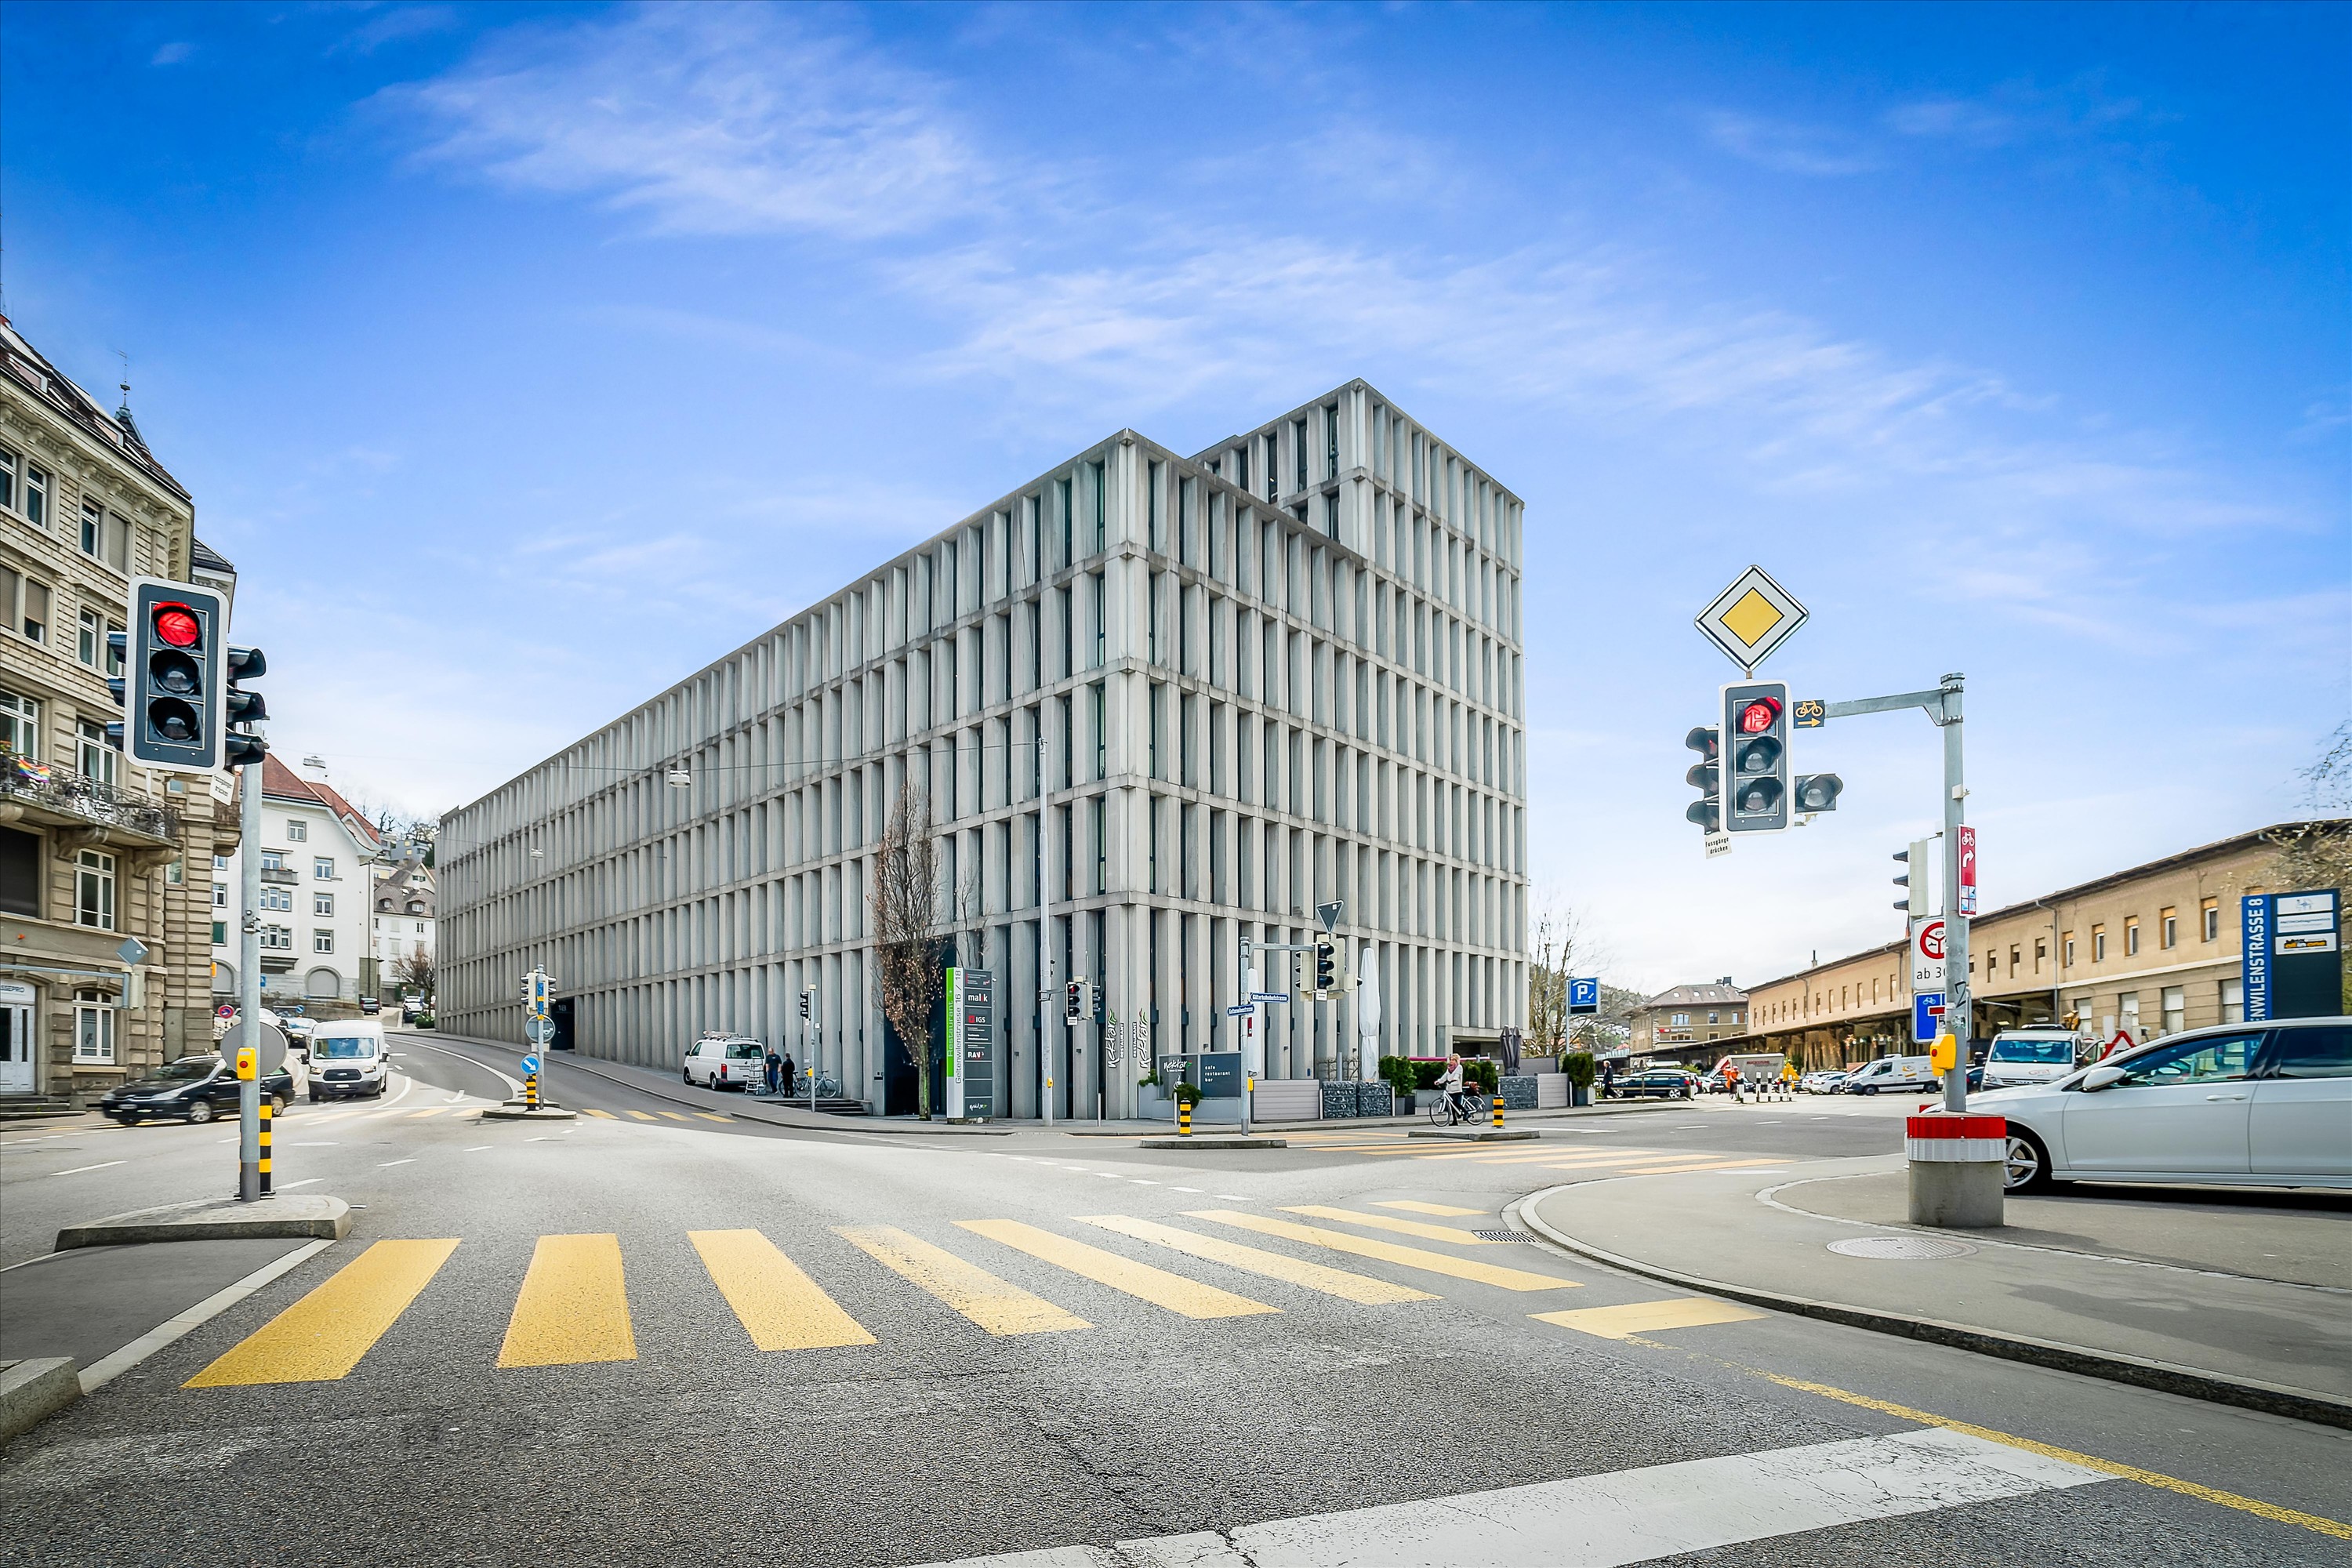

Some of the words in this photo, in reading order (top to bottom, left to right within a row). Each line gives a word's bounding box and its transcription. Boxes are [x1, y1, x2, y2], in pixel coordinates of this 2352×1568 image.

[2248, 898, 2264, 906] 8
[955, 970, 961, 980] 18
[1916, 967, 1931, 980] ab
[955, 993, 961, 1004] 16
